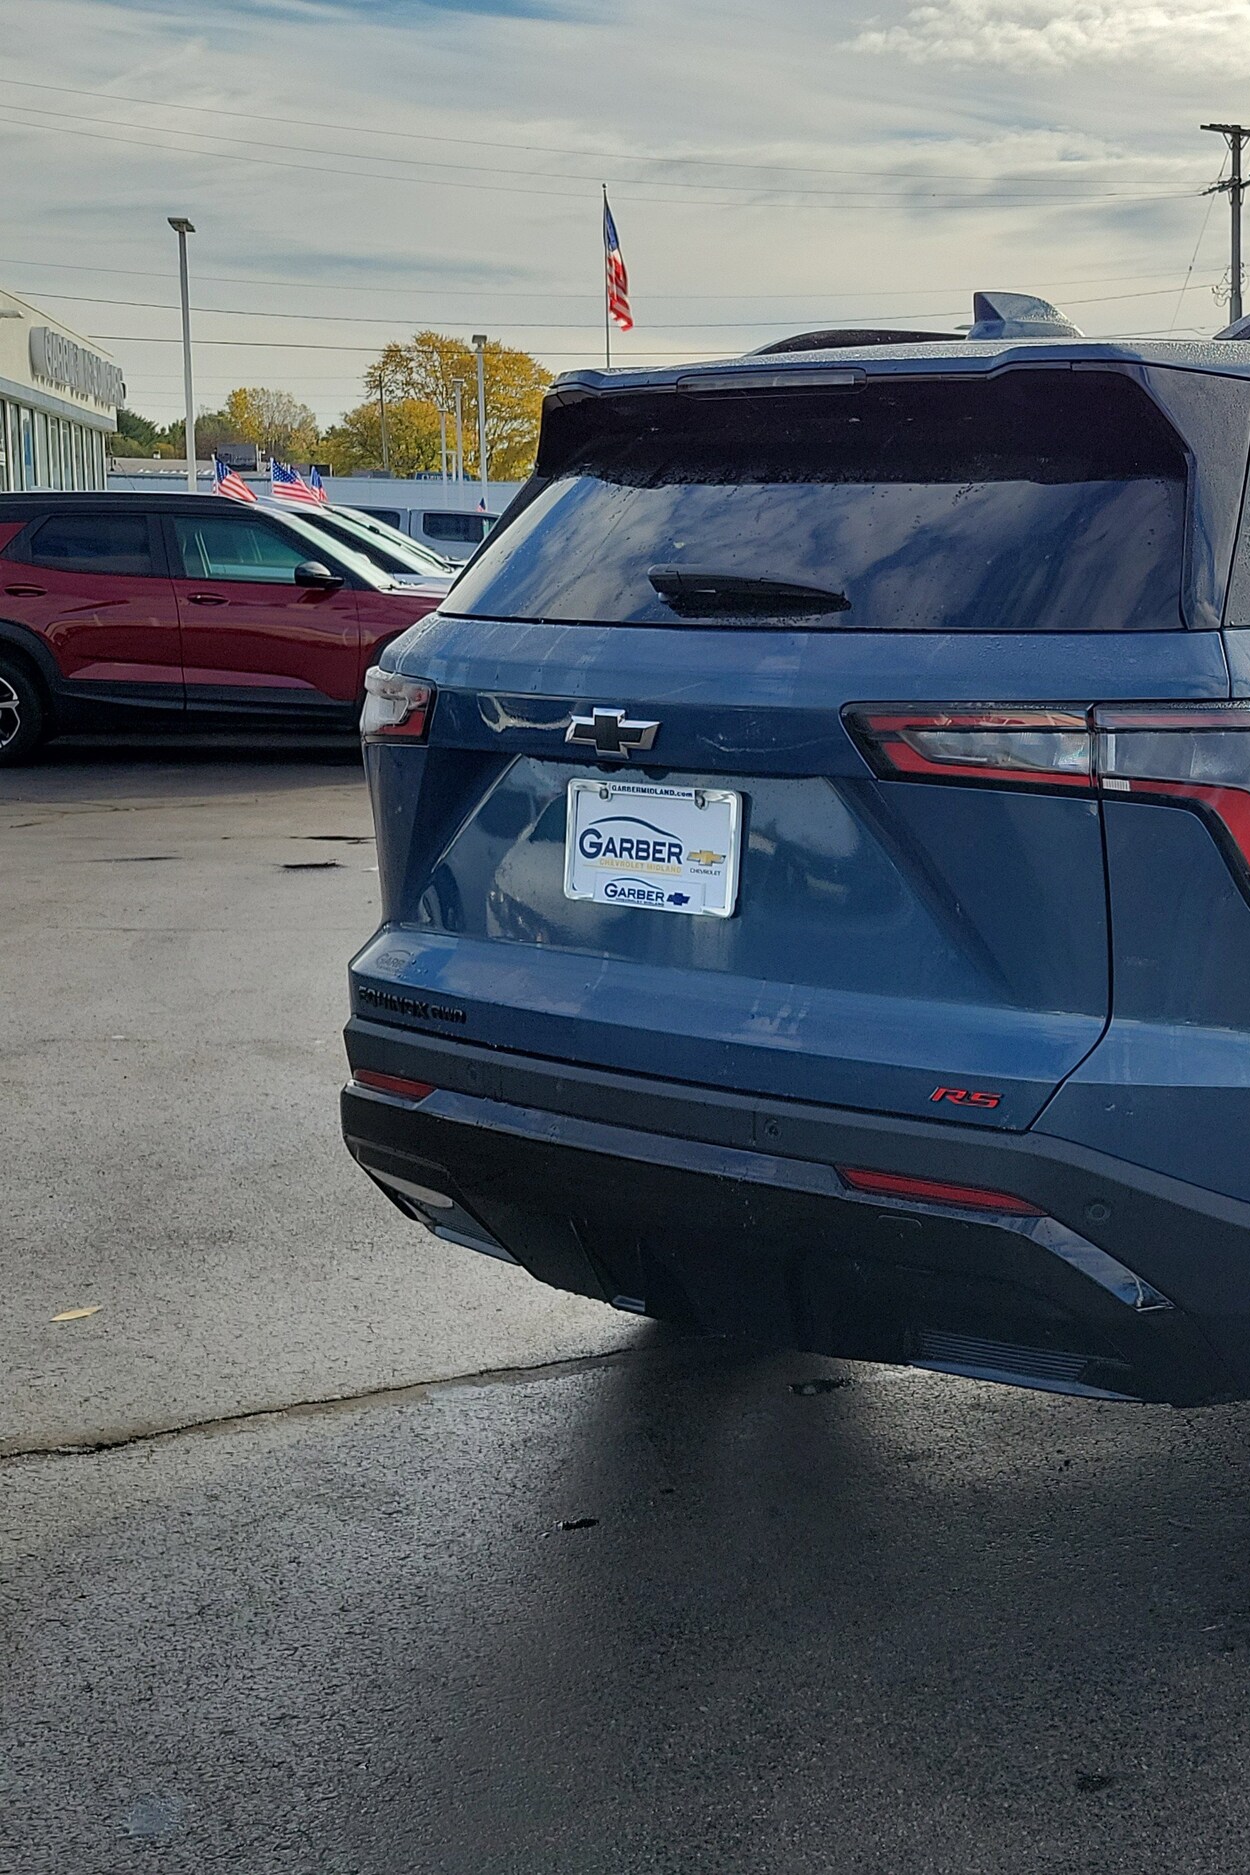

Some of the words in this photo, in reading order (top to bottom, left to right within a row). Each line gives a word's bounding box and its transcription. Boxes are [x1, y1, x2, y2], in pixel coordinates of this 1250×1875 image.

[611, 784, 693, 798] GARBERMIDLAND.com
[578, 827, 684, 865] GARBER
[599, 858, 645, 870] CHEVROLET
[646, 863, 683, 874] MIDLAND
[689, 867, 722, 877] CHEVROLET
[604, 882, 665, 903] GARBER
[929, 1086, 1004, 1109] RS
